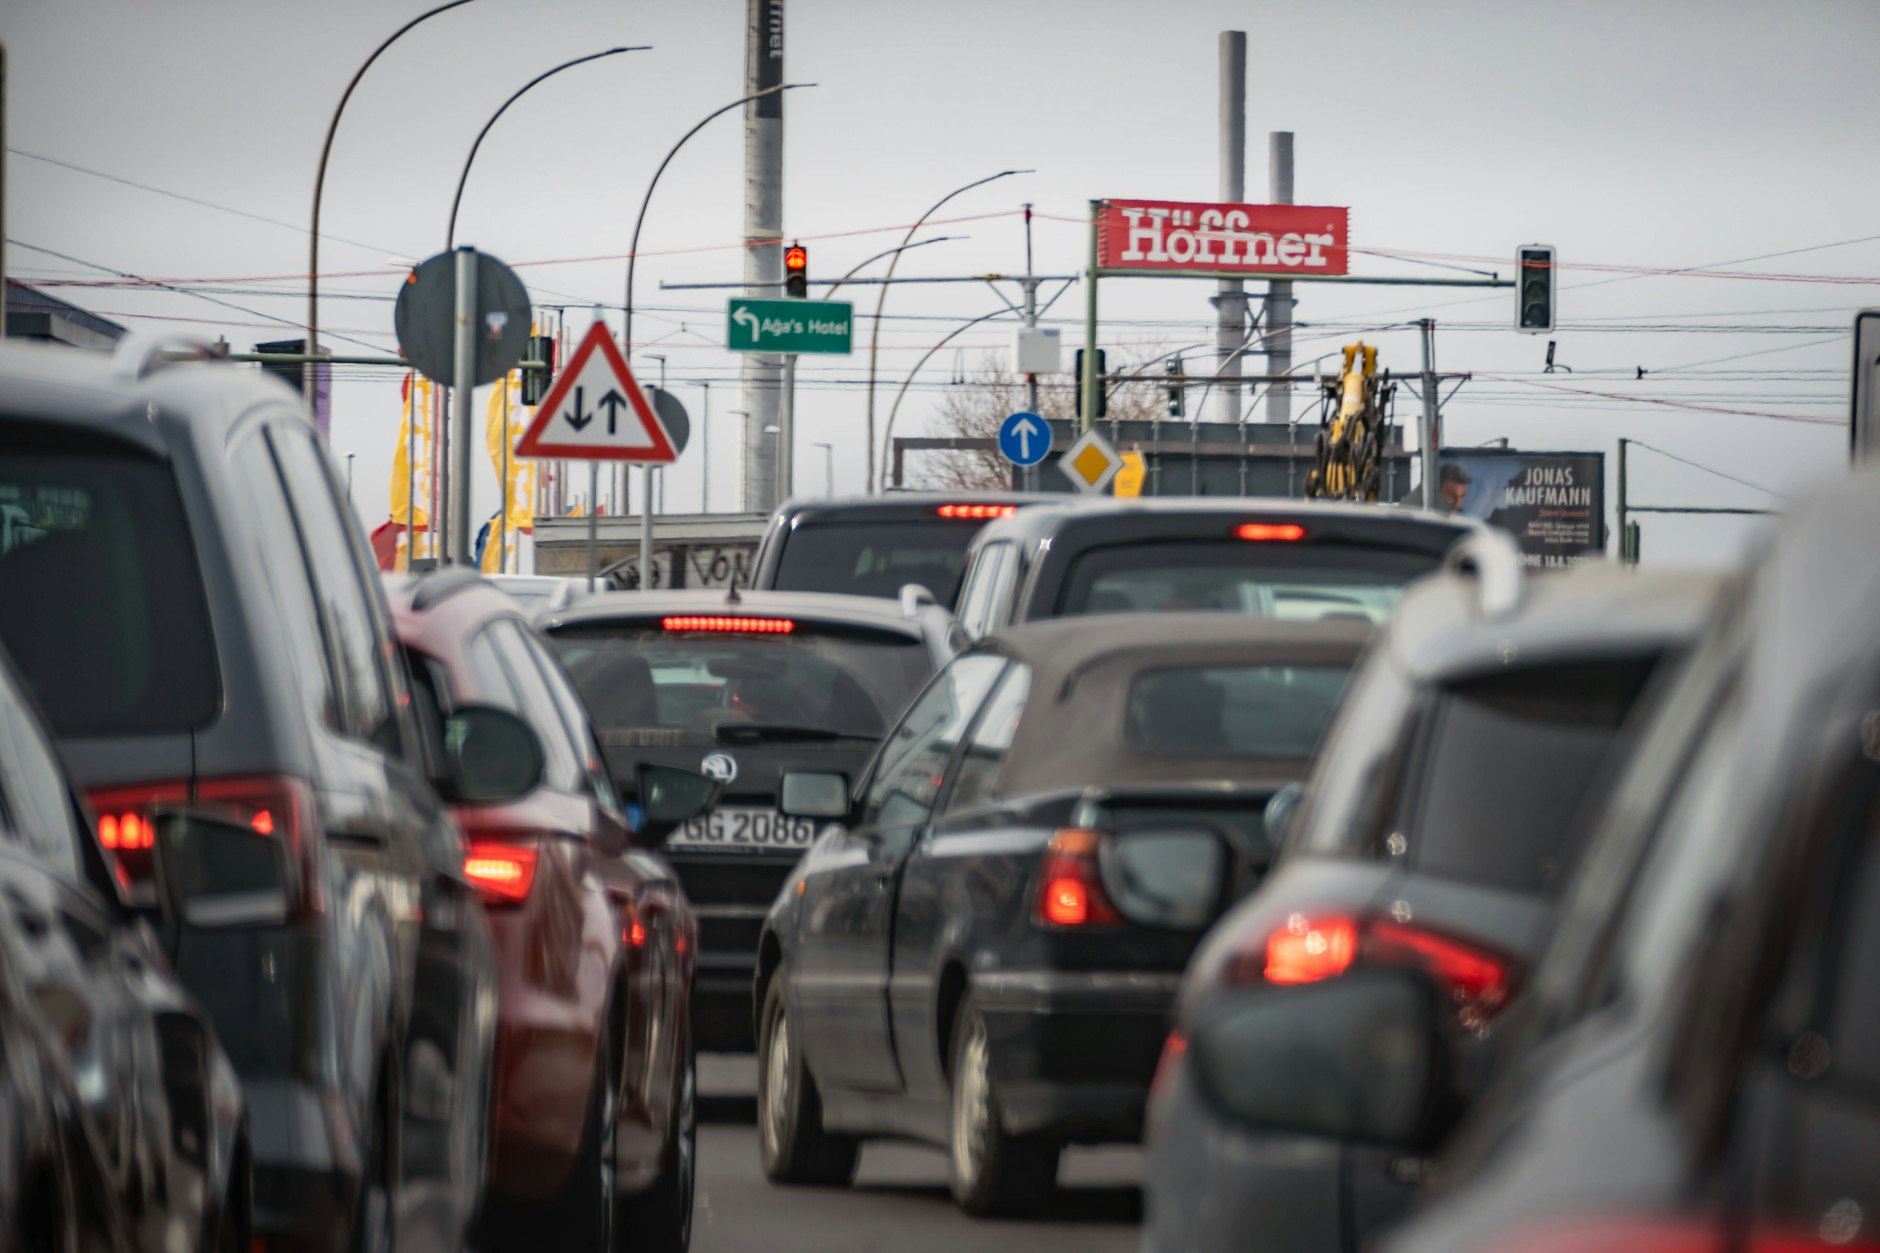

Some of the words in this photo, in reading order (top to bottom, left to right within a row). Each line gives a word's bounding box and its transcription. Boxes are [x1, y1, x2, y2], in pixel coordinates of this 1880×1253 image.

[1121, 206, 1335, 267] Höffner
[808, 319, 848, 336] Hotel
[1524, 467, 1573, 486] JONAS
[1505, 487, 1591, 506] KAUFMANN
[732, 812, 810, 844] 2086
